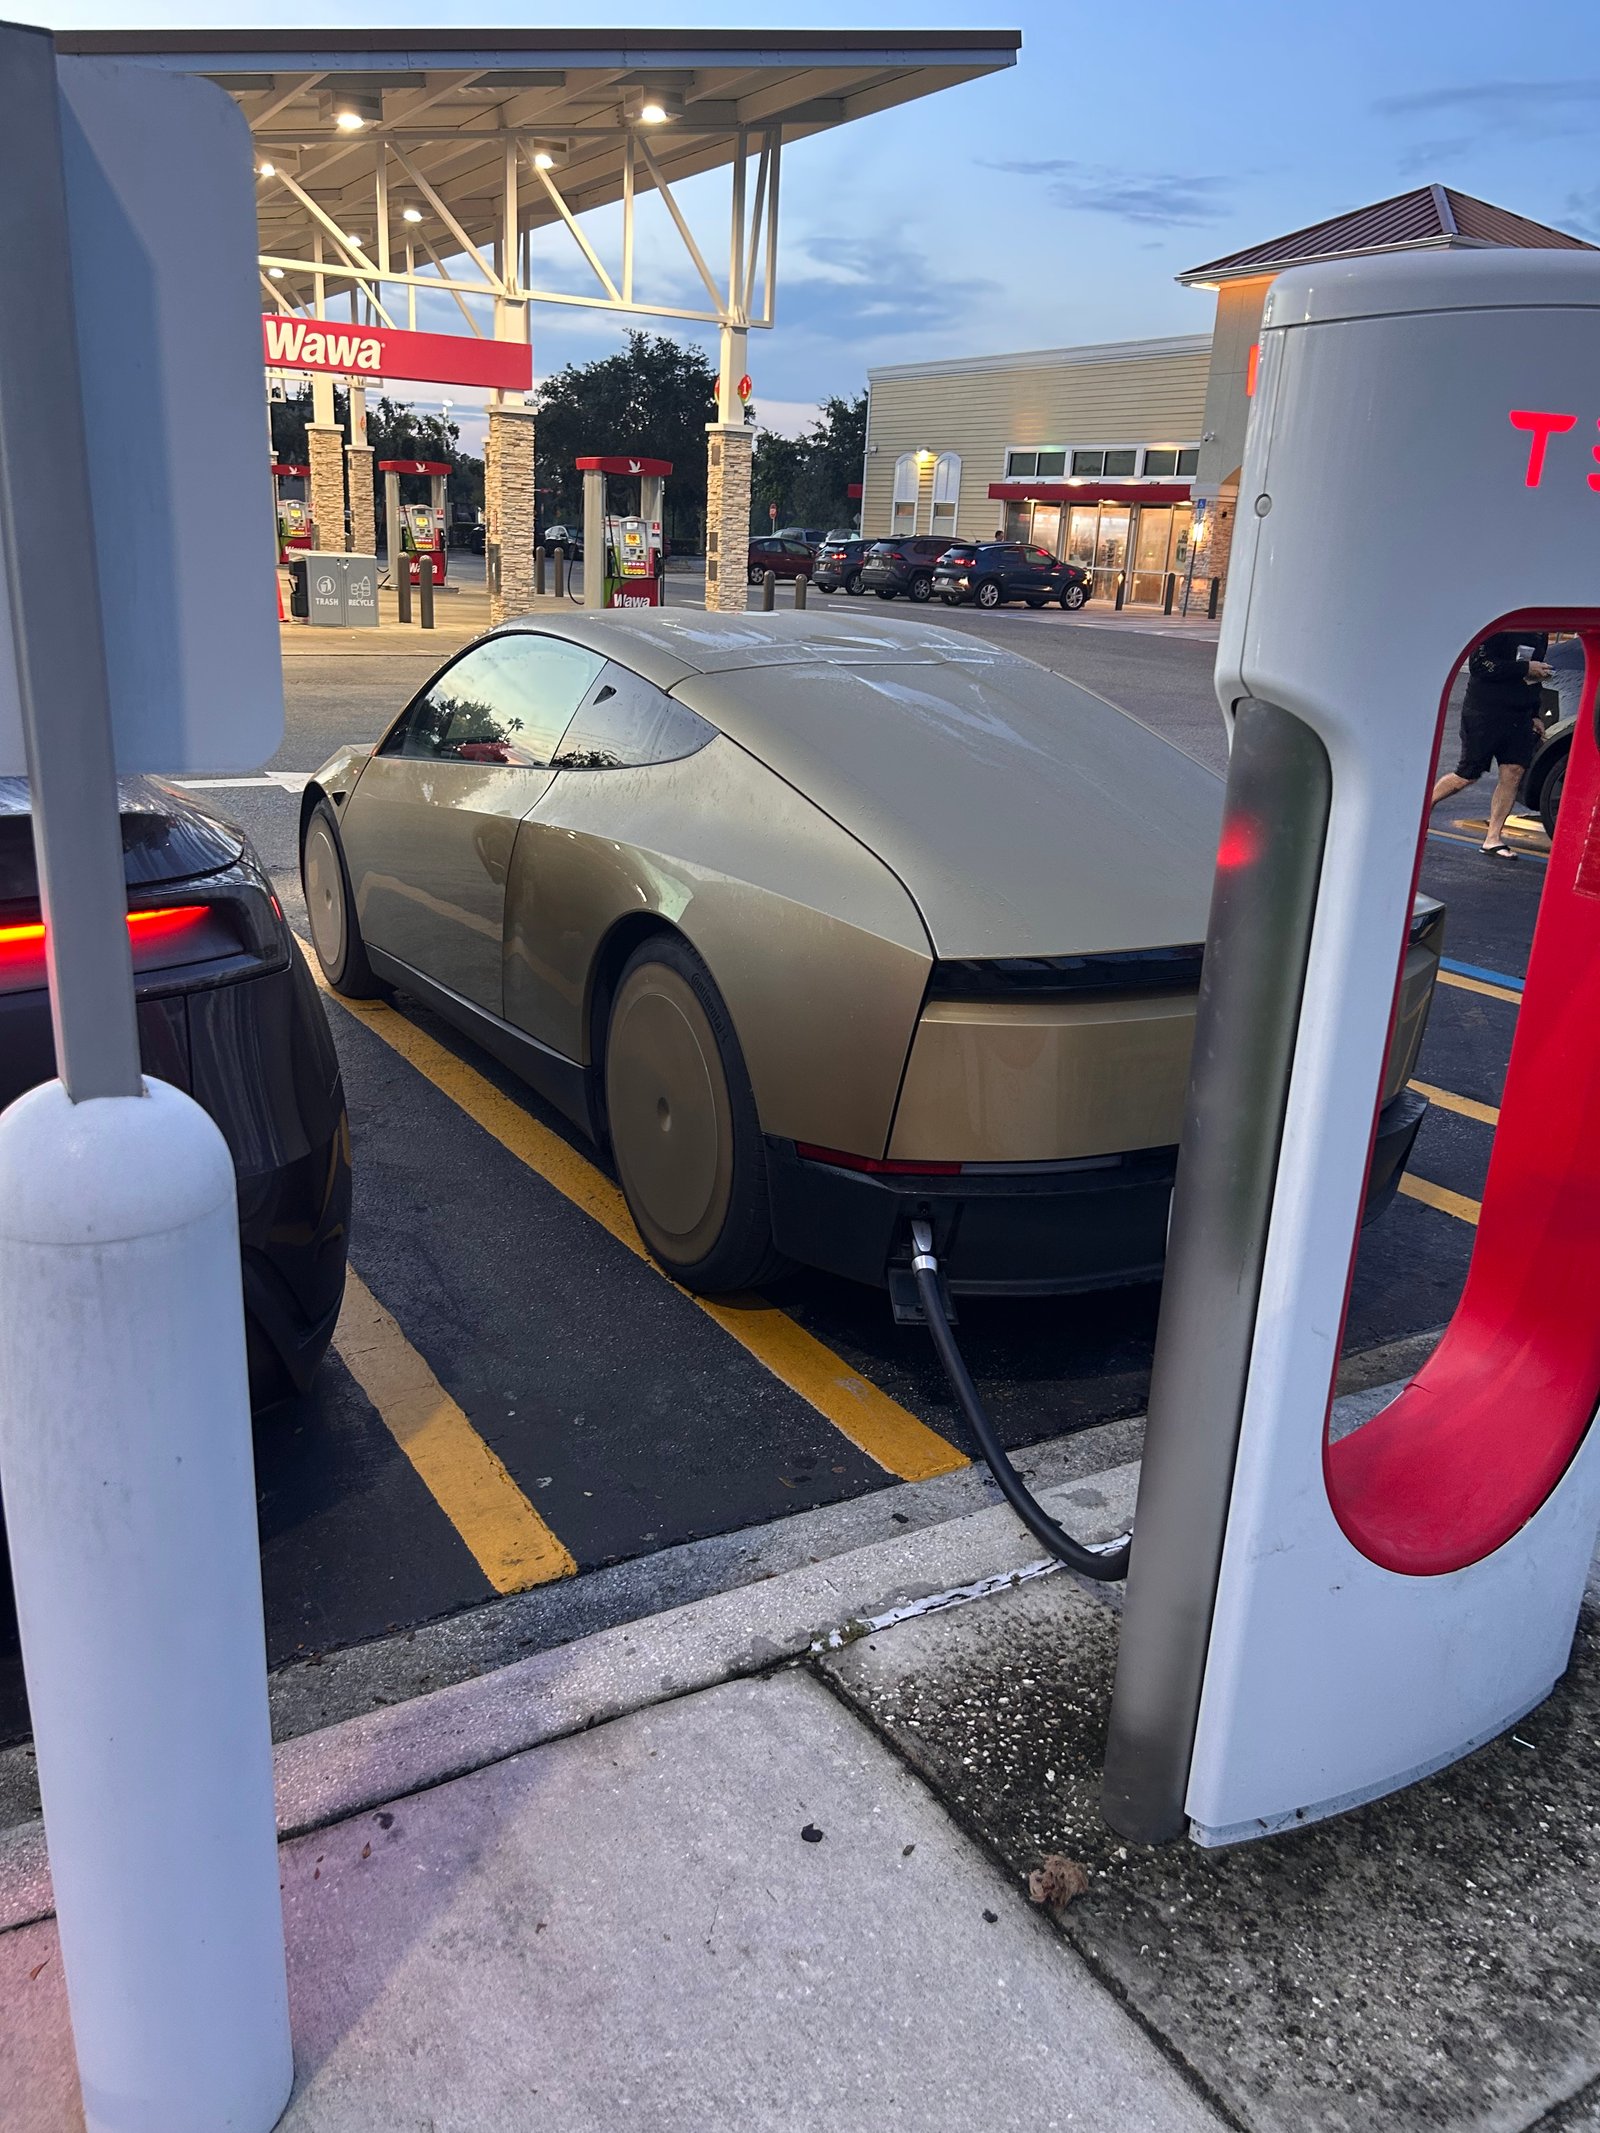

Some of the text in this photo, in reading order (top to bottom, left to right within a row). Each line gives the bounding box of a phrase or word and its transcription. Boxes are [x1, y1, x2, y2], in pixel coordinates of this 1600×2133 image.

[265, 320, 382, 370] Wawa
[1509, 409, 1600, 492] T
[315, 597, 338, 606] TRASH
[348, 599, 375, 607] RECYCLE
[613, 594, 651, 607] Wawa
[691, 973, 725, 1033] Continental
